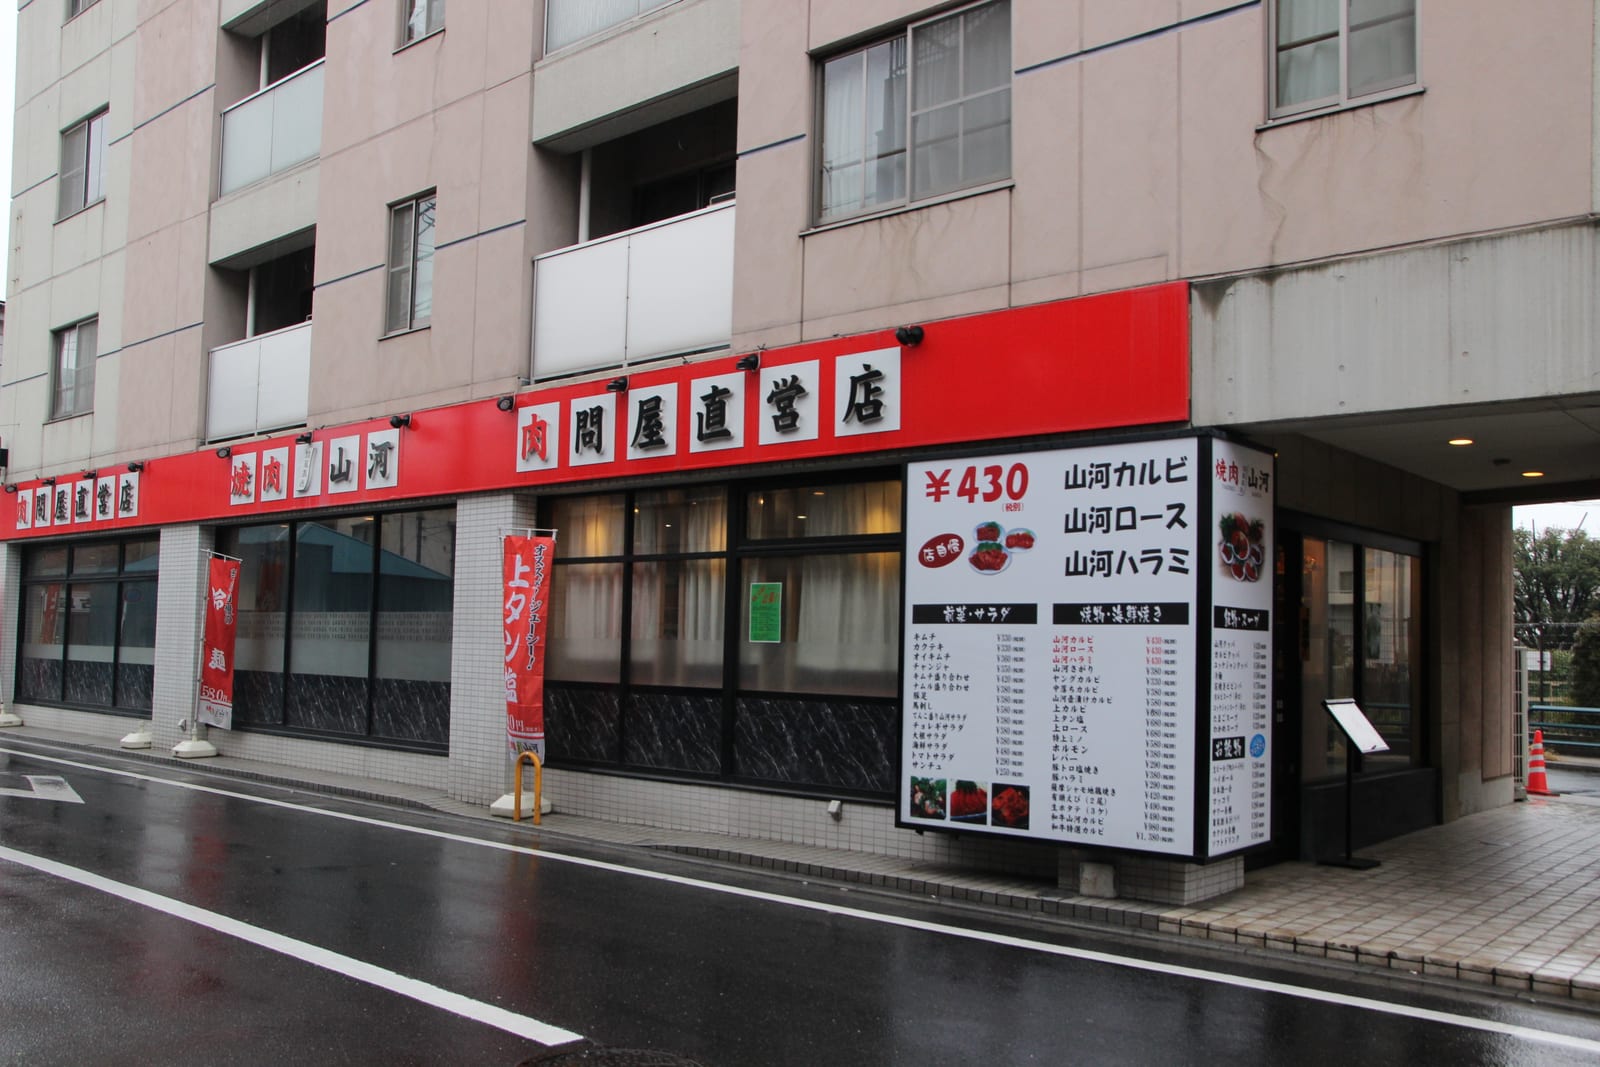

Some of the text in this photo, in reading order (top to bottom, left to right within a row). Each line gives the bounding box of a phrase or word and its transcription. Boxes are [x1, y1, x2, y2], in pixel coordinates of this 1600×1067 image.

[521, 363, 885, 461] 肉問屋直営店
[231, 455, 281, 496] 焼肉
[330, 441, 394, 483] 山河
[925, 462, 1029, 503] ¥430
[1064, 455, 1188, 490] 山河カルビ
[1215, 458, 1239, 487] 焼肉
[1248, 466, 1270, 494] 山河
[17, 479, 134, 525] 肉問屋直営店
[1064, 502, 1188, 534] 山河ロース
[1065, 547, 1190, 578] 山河ハラミ
[914, 632, 936, 641] キムチ
[1052, 635, 1094, 644] 山河カルビ
[1052, 645, 1094, 654] 山河ロース
[1052, 655, 1092, 664] 山河ハラミ
[1053, 704, 1087, 714] 上カルビ
[1052, 724, 1088, 734] 上ロース
